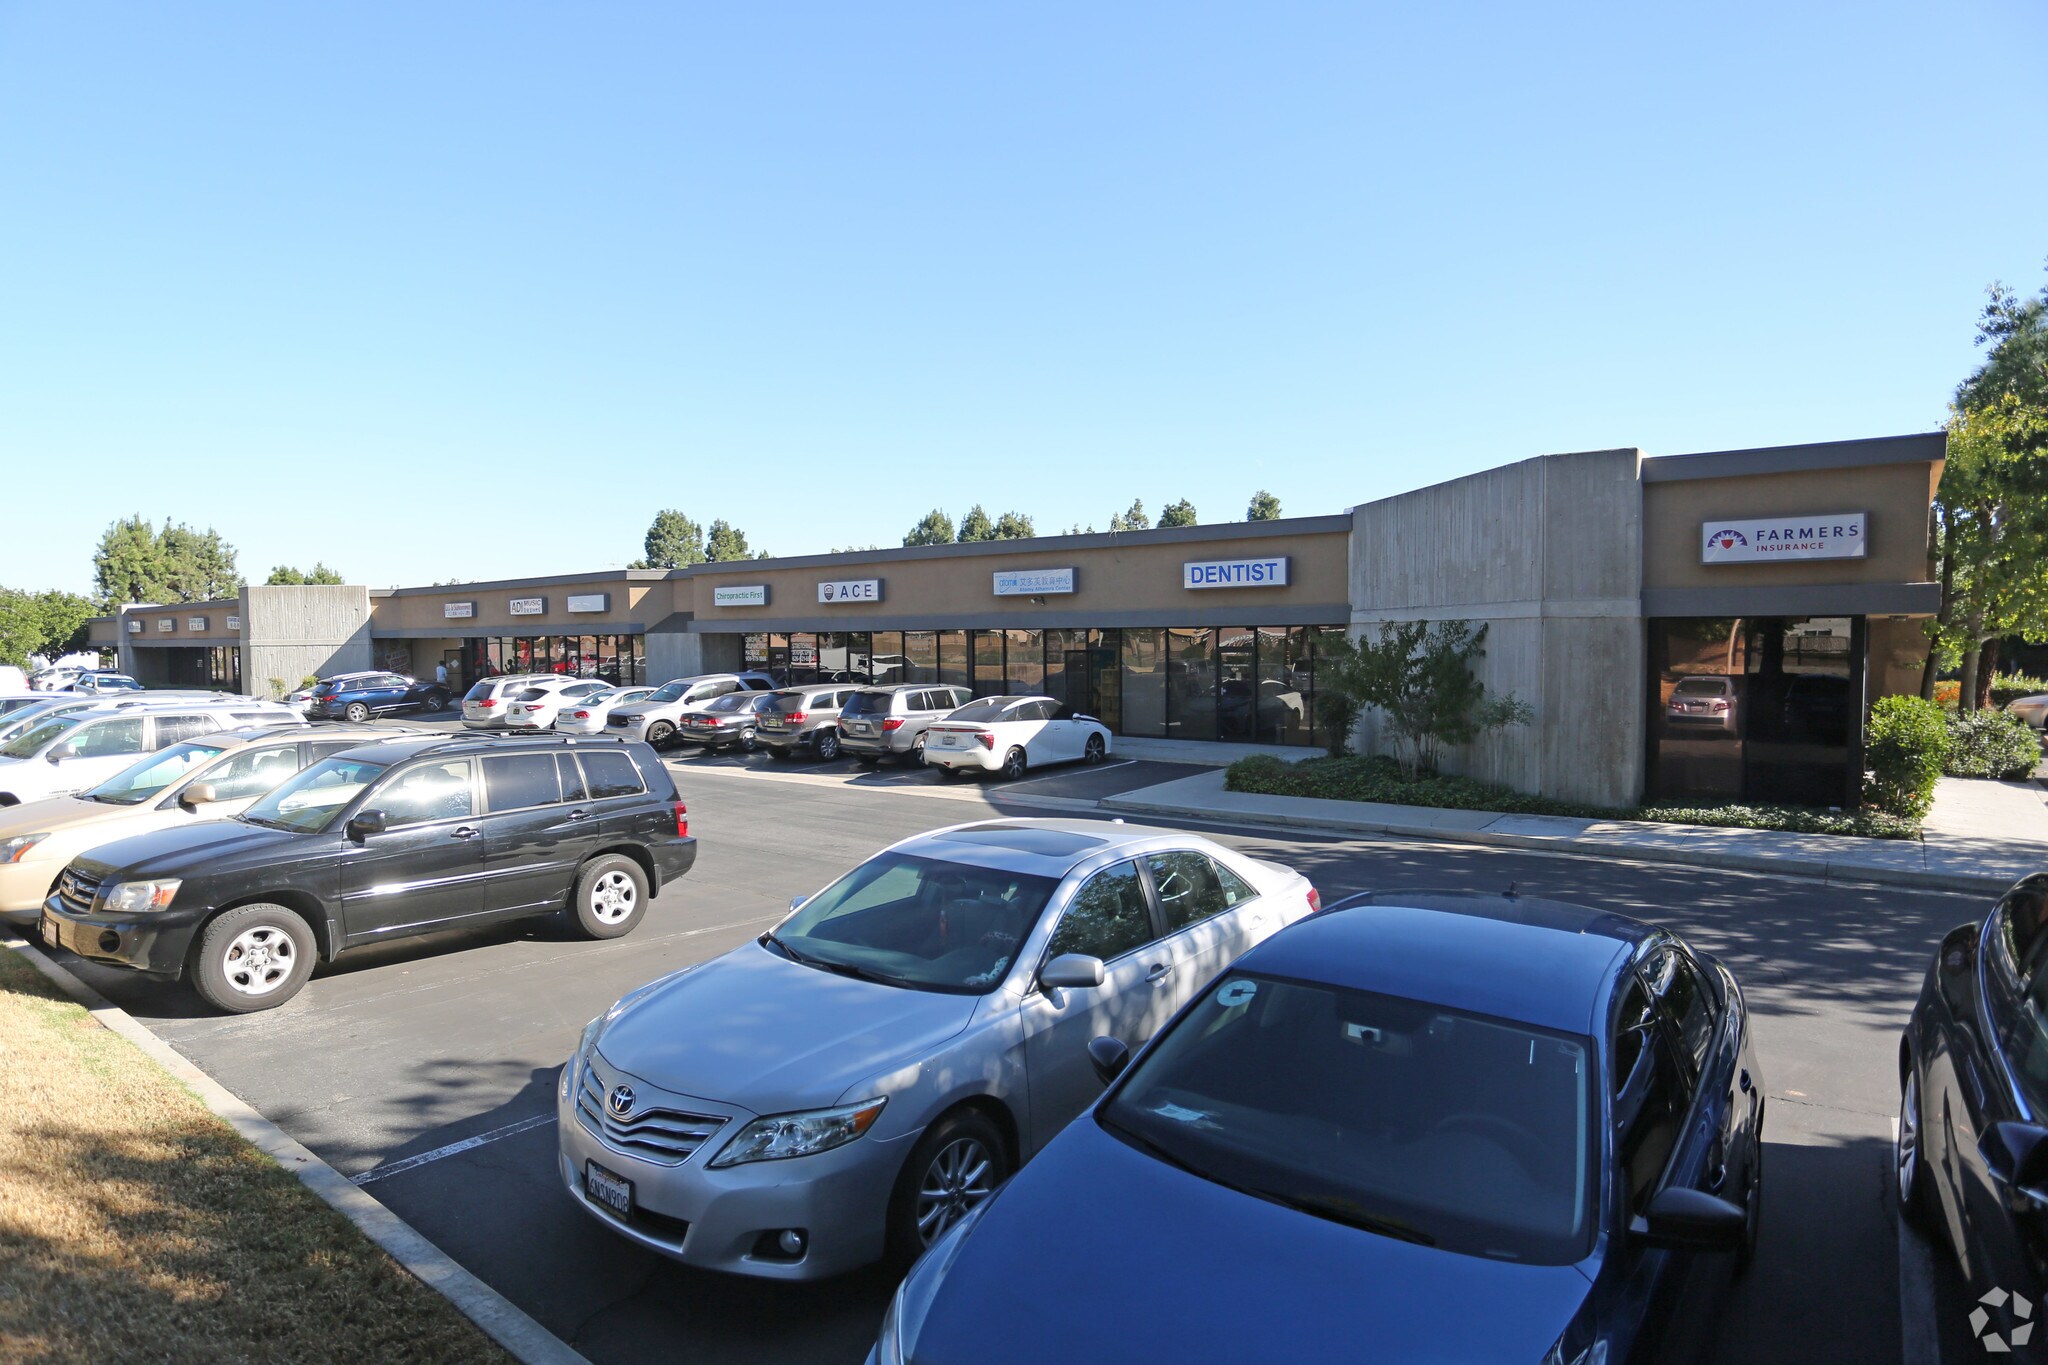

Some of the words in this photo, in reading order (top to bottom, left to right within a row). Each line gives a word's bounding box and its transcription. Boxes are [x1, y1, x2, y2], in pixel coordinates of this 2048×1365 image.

[1756, 524, 1859, 541] FARMERS
[1756, 542, 1825, 552] INSURANCE
[1190, 563, 1278, 584] DENTIST
[716, 592, 750, 601] Chiropractic
[750, 591, 763, 599] First
[840, 584, 872, 599] ACE
